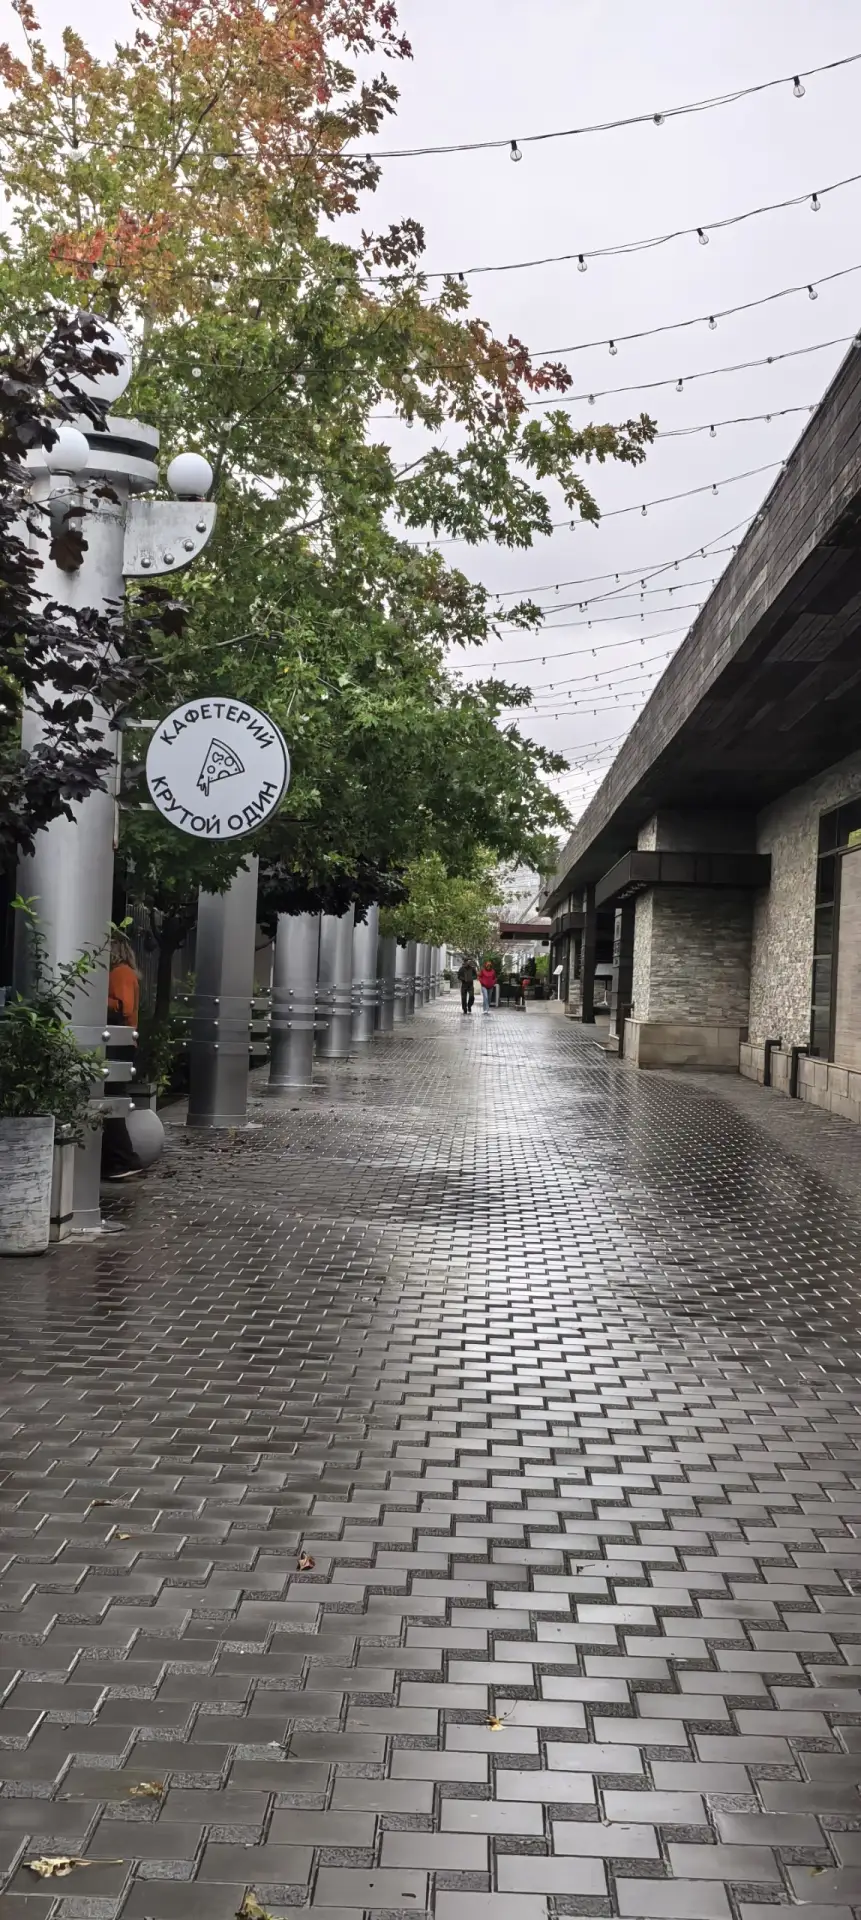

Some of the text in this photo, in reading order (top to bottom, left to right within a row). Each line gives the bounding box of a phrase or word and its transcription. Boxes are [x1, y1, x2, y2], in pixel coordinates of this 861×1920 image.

[160, 703, 275, 749] КАФЕТЕРИЙ
[151, 776, 278, 834] КРУТОЙ ОДИН
